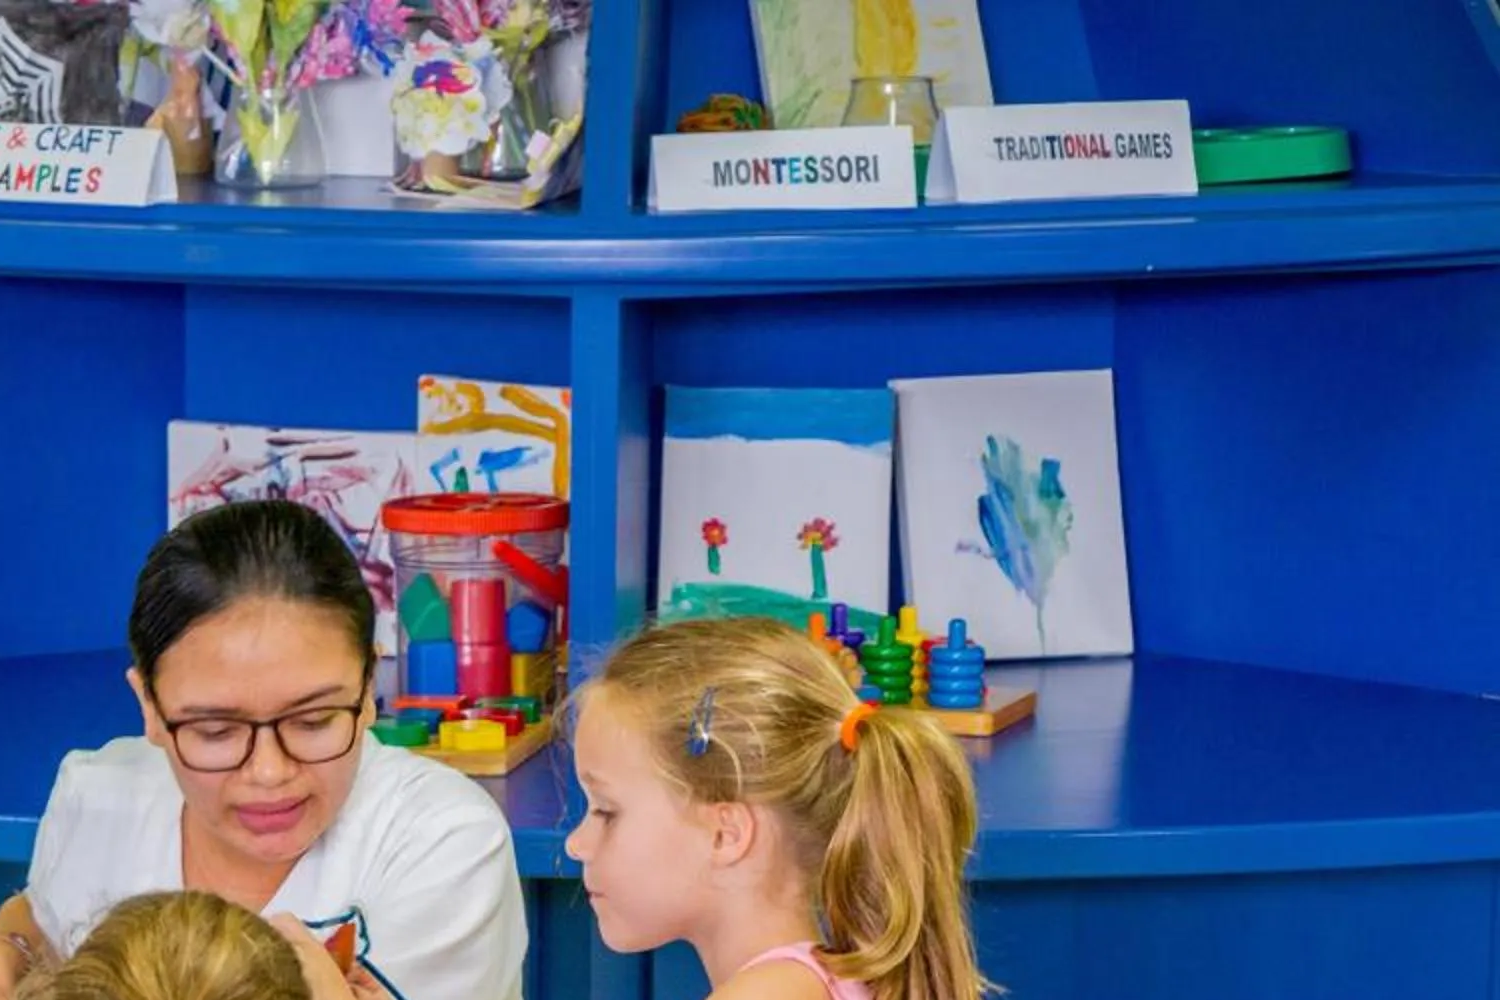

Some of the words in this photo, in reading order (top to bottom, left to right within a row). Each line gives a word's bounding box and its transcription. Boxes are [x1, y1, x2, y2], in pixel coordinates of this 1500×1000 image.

[6, 125, 27, 150] &
[35, 126, 123, 154] CRAFT
[993, 134, 1112, 162] TRADITIONAL
[1114, 132, 1174, 160] GAMES
[712, 154, 880, 187] MONTESSORI
